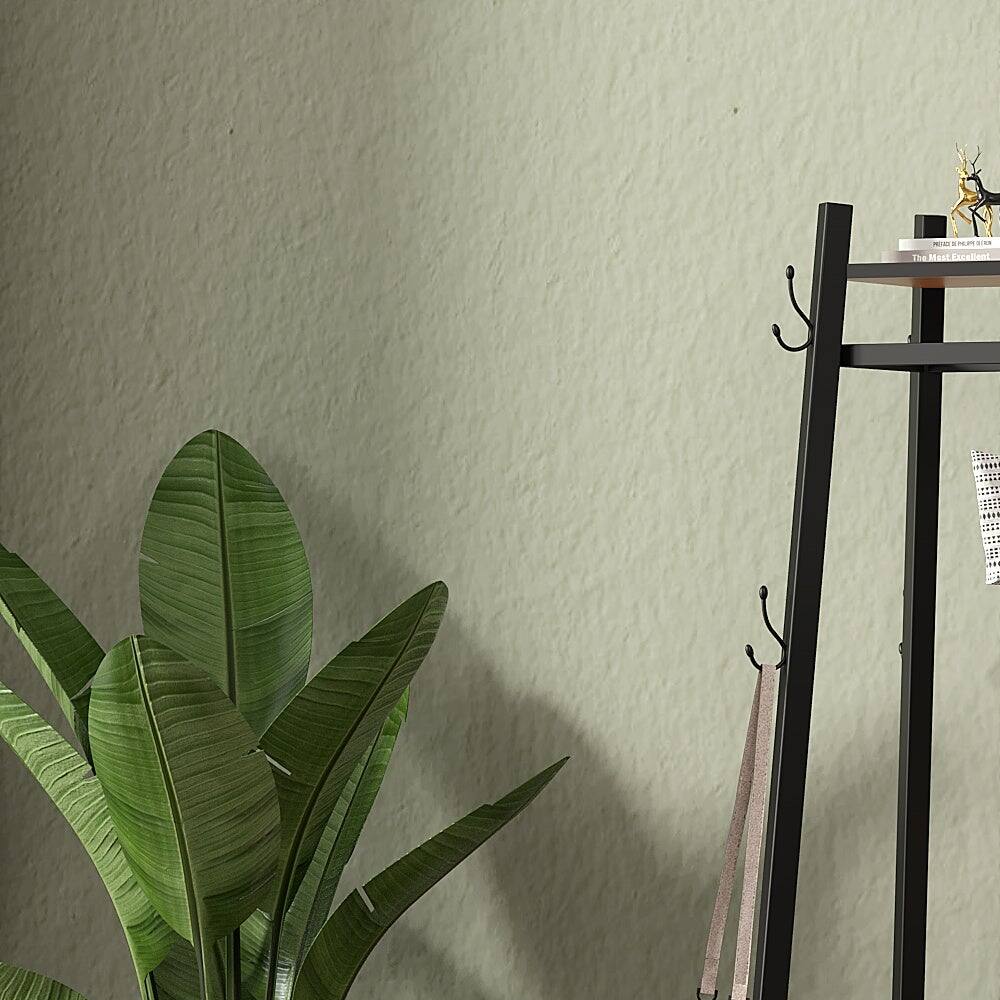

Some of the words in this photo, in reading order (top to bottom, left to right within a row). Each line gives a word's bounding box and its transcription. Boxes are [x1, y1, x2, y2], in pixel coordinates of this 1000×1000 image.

[912, 253, 927, 262] The
[928, 253, 951, 262] Most
[951, 252, 991, 261] Excellent
